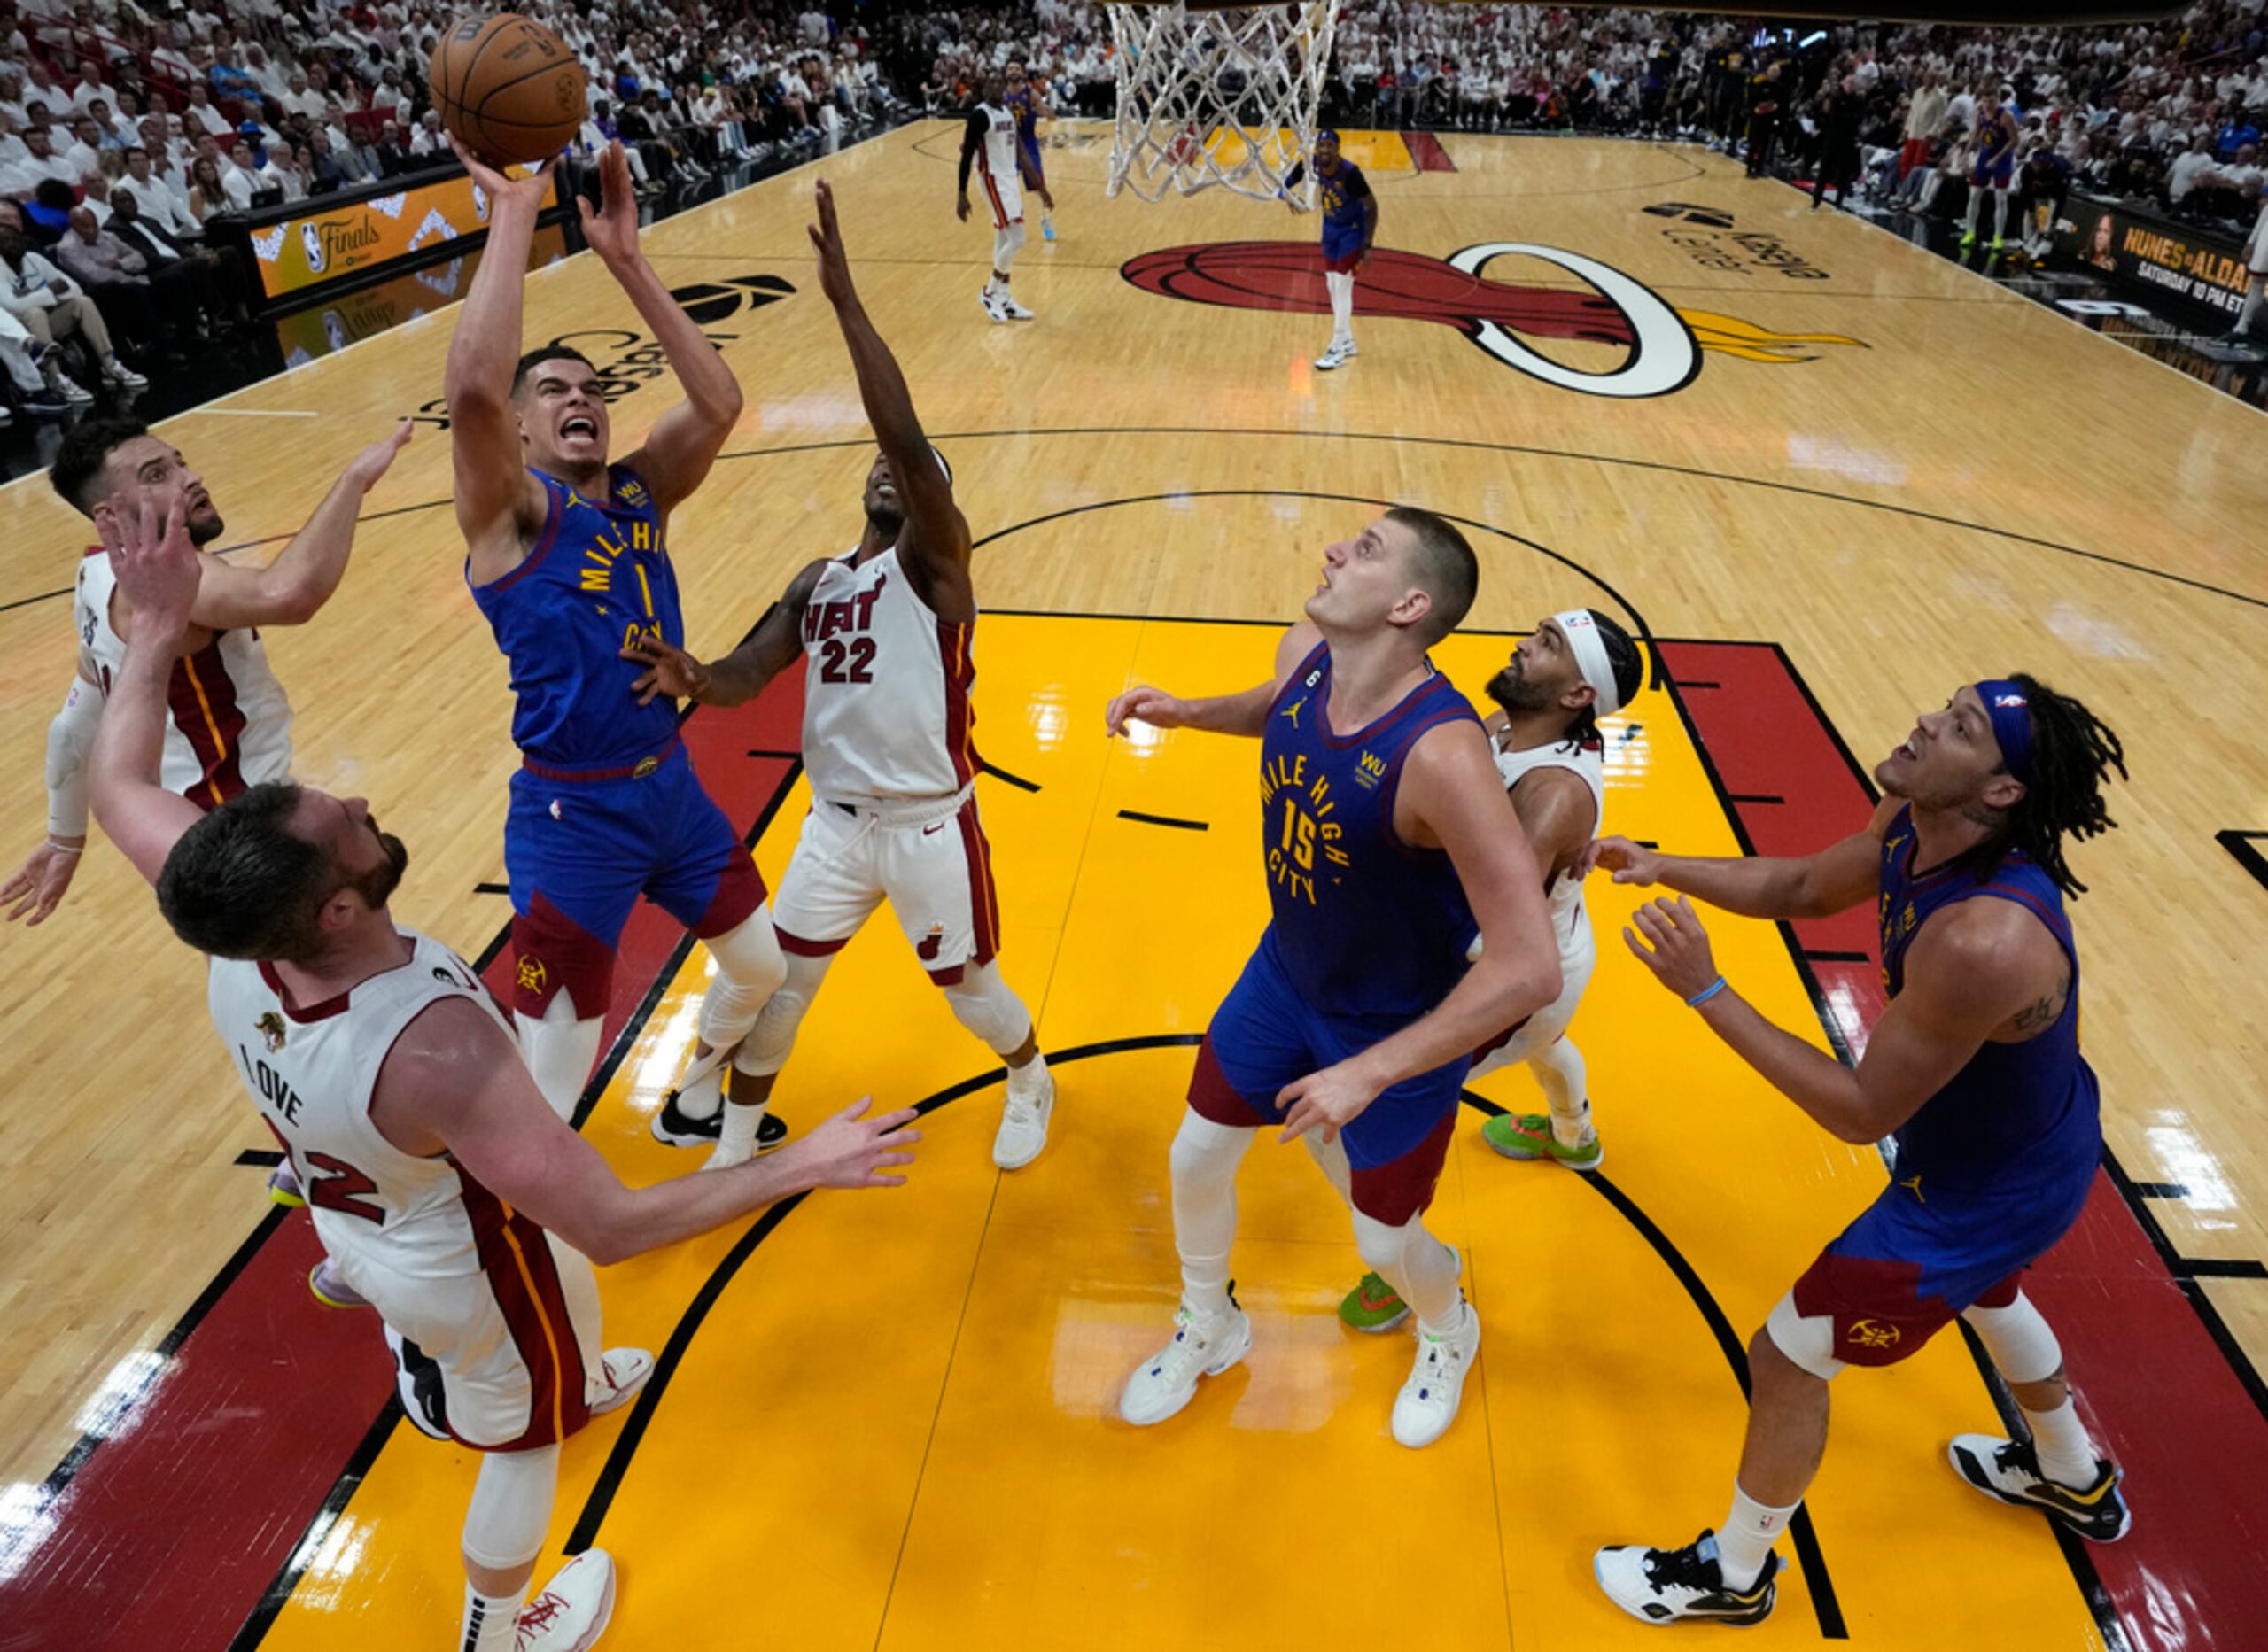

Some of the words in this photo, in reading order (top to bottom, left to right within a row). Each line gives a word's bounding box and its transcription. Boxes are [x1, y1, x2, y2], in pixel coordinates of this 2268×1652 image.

[320, 213, 380, 272] Finals
[2124, 227, 2186, 270] NUNES
[2190, 250, 2256, 296] ALDA
[2138, 260, 2194, 293] SATURDAY
[2193, 281, 2207, 300] 10
[2205, 286, 2227, 308] PM
[2225, 294, 2245, 313] ET
[633, 522, 660, 554] HI
[634, 563, 654, 617] 1
[804, 574, 886, 642] HEAT
[821, 637, 876, 684] 22
[1306, 670, 1321, 687] 6
[1360, 750, 1387, 777] WU
[1260, 754, 1308, 805] MILE
[1310, 774, 1350, 867] HIGH
[1282, 797, 1317, 871] 15
[1269, 848, 1317, 905] CITY
[240, 1043, 303, 1128] LOVE
